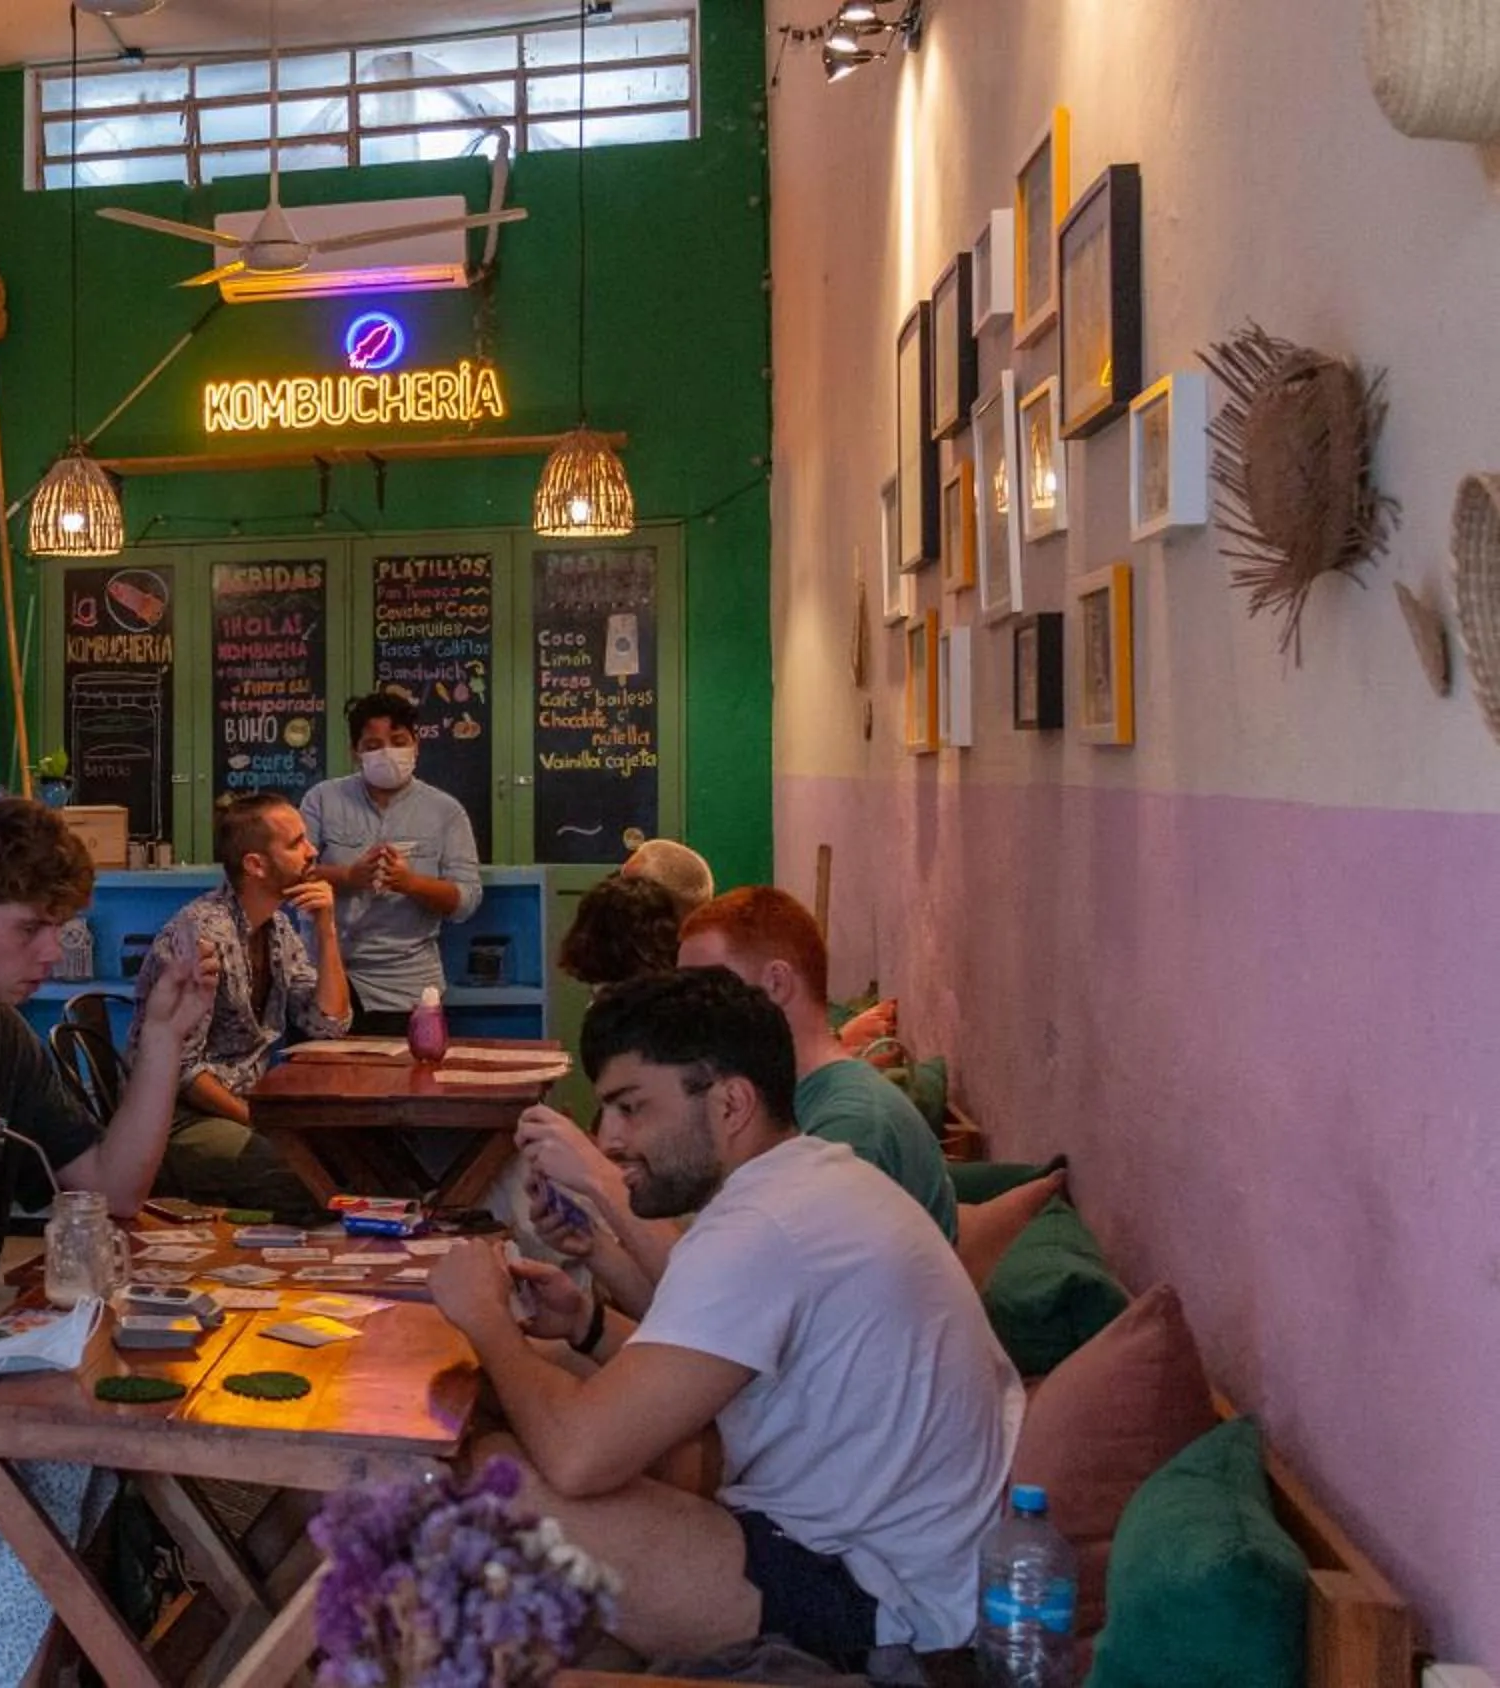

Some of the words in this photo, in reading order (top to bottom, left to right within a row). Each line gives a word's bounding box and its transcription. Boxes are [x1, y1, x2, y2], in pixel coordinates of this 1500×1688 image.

[538, 630, 586, 646] Coco
[540, 670, 592, 688] Fresa
[595, 687, 654, 708] baileys
[591, 724, 651, 746] nutella
[539, 749, 601, 770] Vainilla
